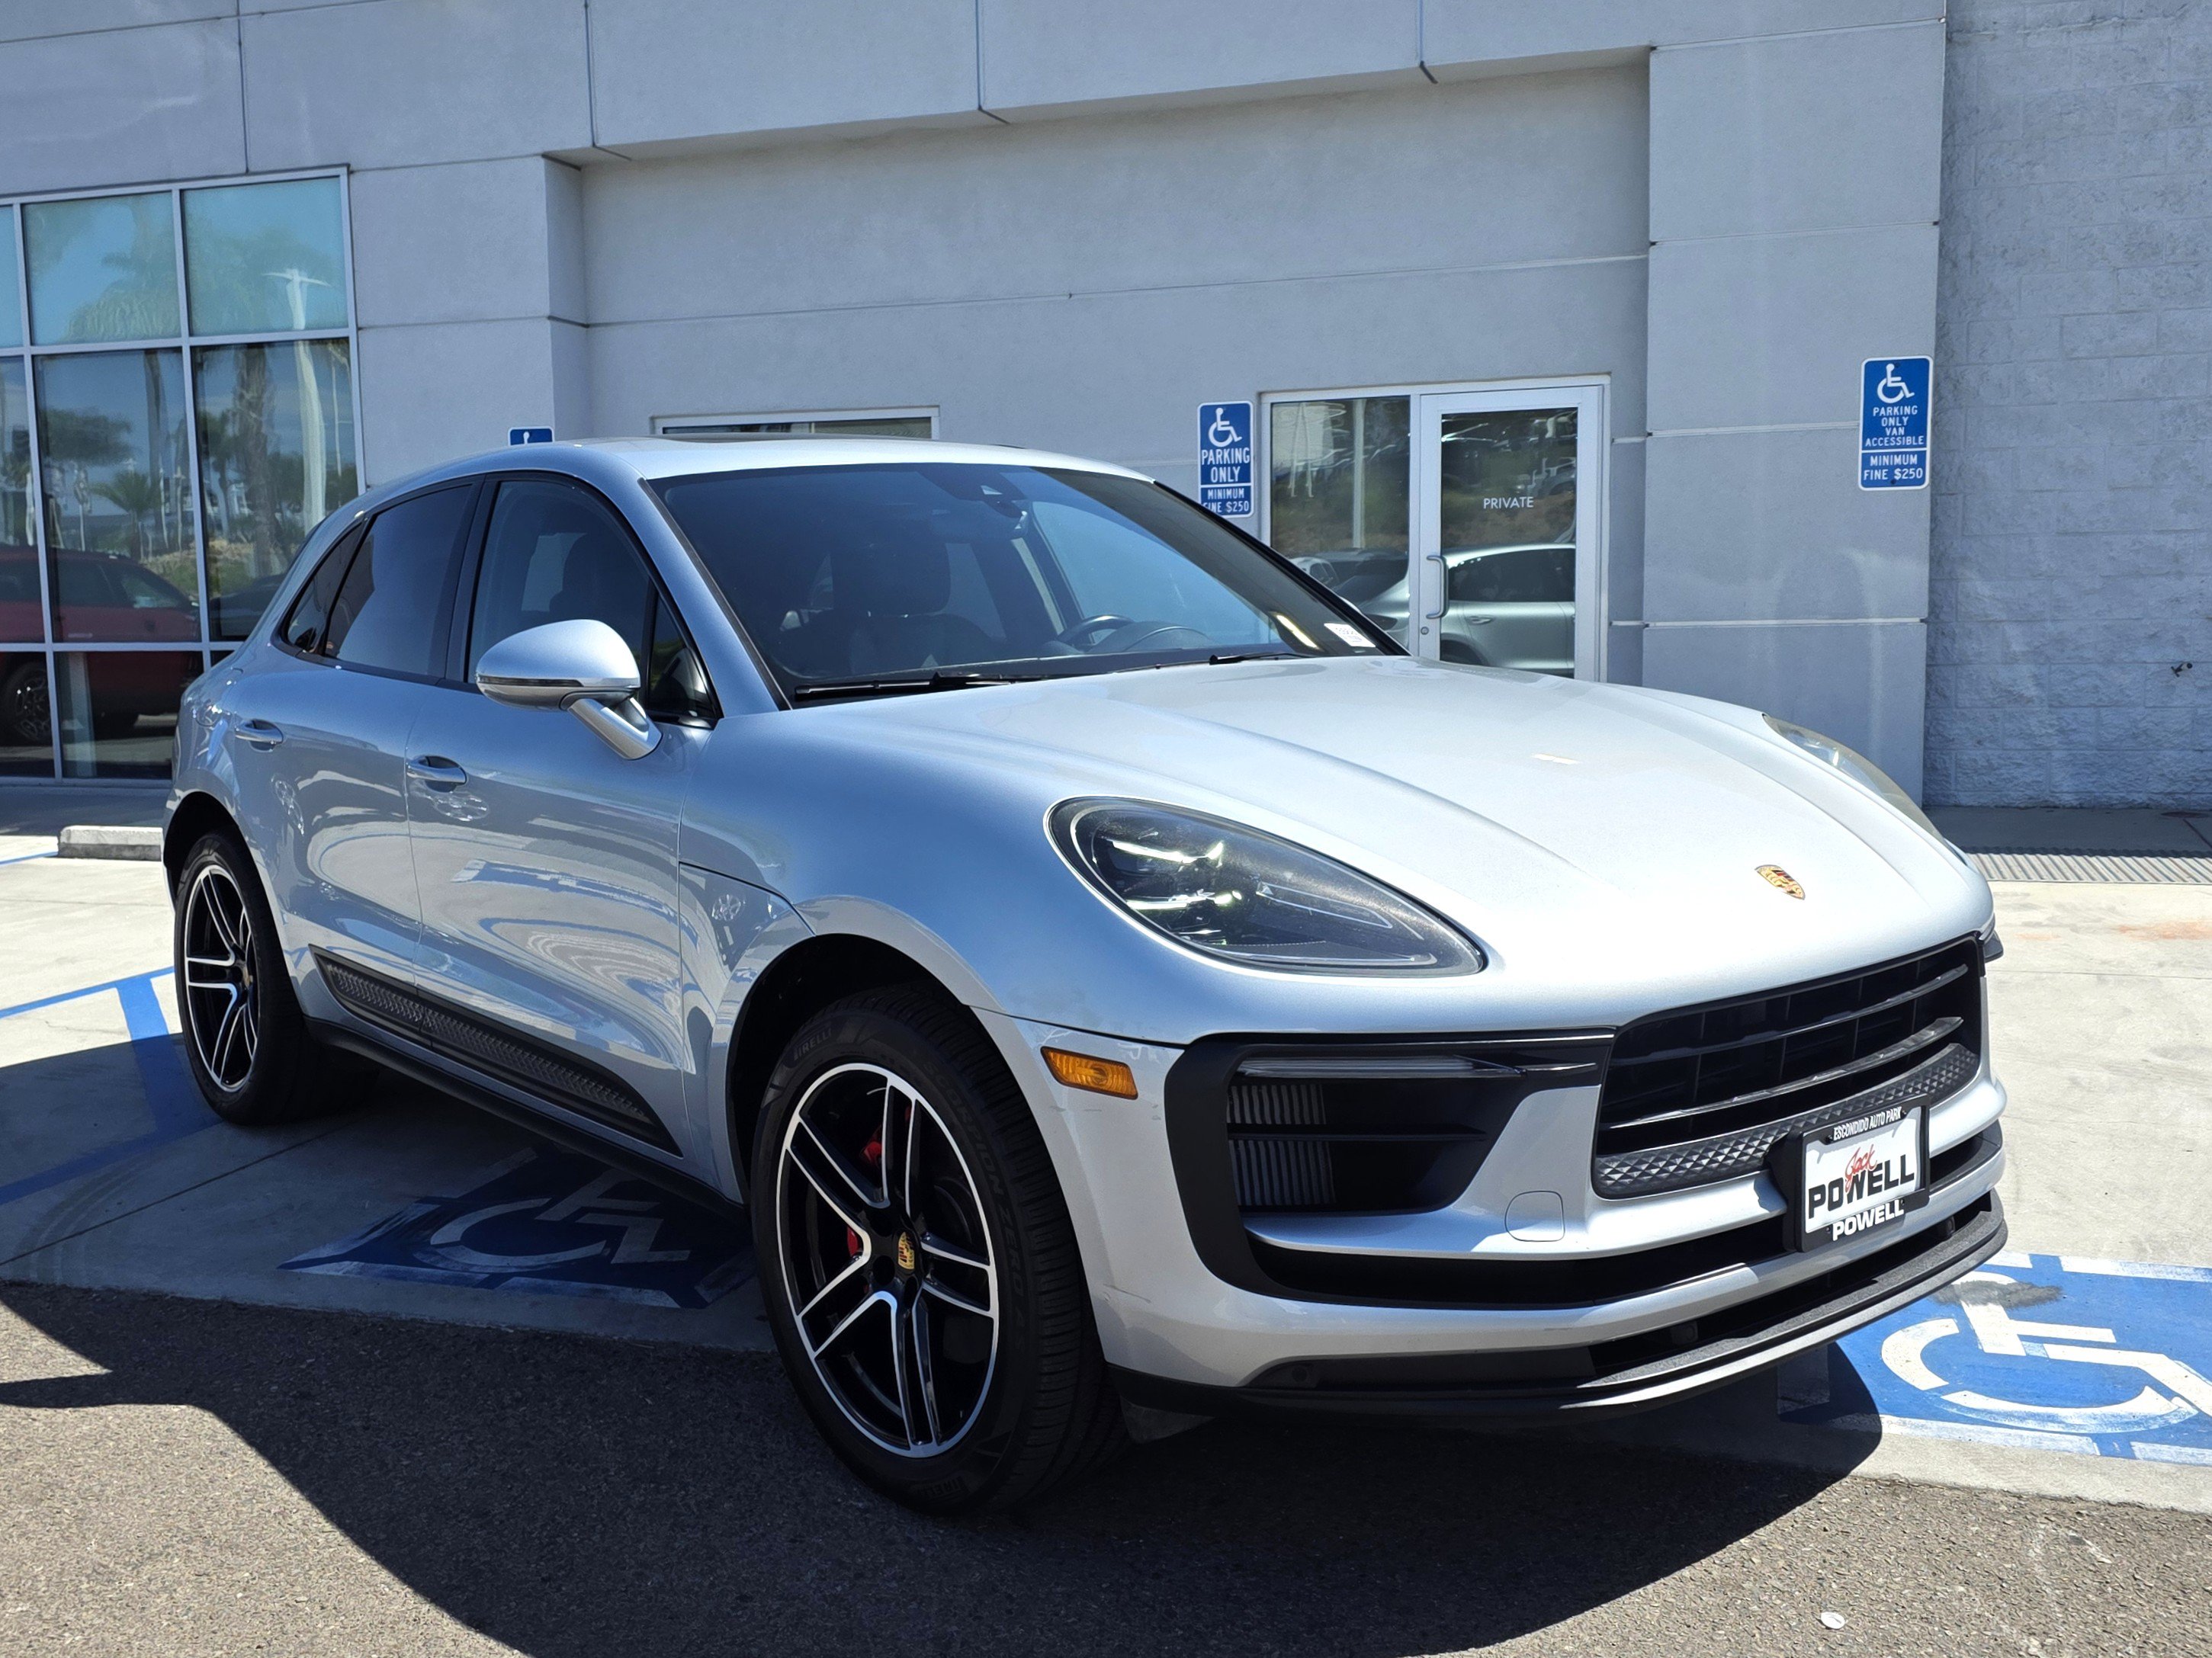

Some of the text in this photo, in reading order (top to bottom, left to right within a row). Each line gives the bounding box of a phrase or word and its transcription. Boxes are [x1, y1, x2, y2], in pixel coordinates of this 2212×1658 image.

[1873, 406, 1918, 416] PARKING
[1881, 416, 1909, 426] ONLY
[1885, 426, 1904, 435] VAN
[1865, 435, 1924, 447] ACCESSIBLE
[1202, 448, 1250, 464] PARKING
[1870, 454, 1917, 466] MINIMUM
[1210, 466, 1241, 483] ONLY
[1863, 467, 1922, 480] FINE $250
[1208, 489, 1244, 499] MINIMUM
[1226, 501, 1249, 512] $250
[1483, 496, 1534, 509] PRIVATE
[1833, 1106, 1902, 1141] ESCONDIDO AUTO PARK
[1845, 1143, 1878, 1194] Jack
[1808, 1153, 1915, 1220] POWELL
[1832, 1199, 1905, 1242] POWELL
